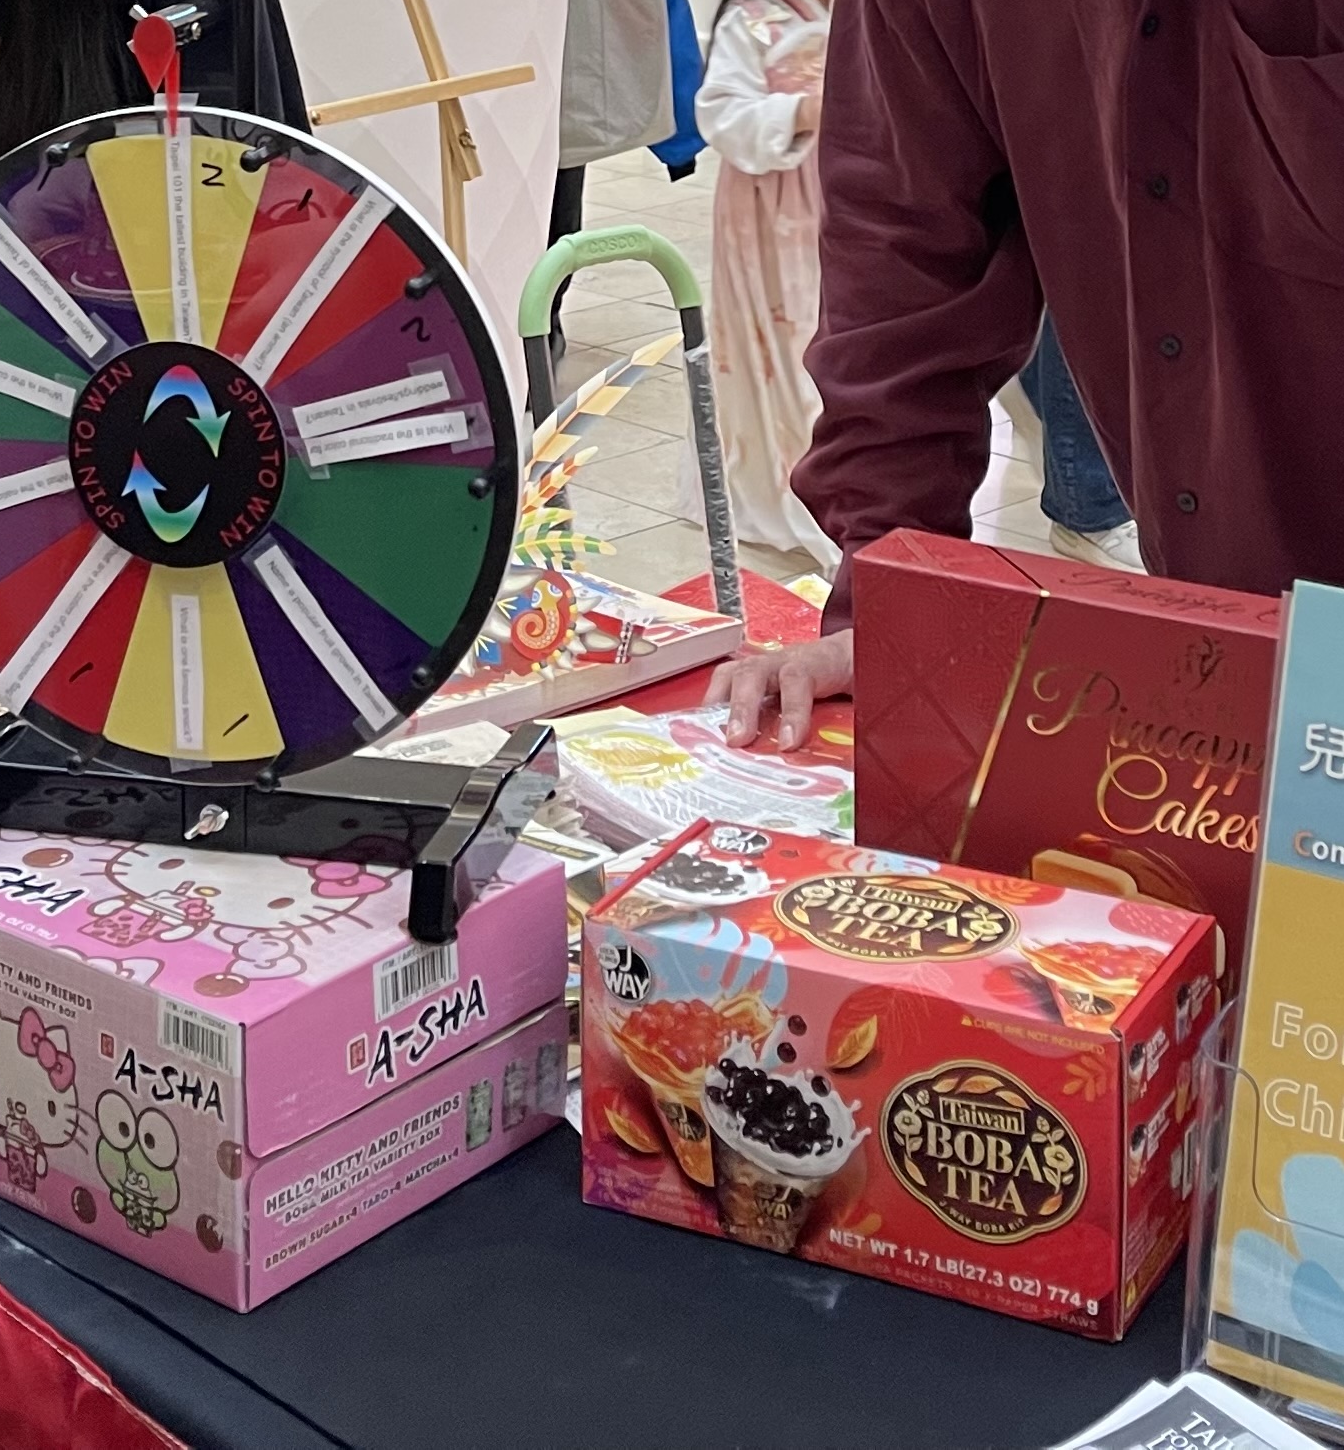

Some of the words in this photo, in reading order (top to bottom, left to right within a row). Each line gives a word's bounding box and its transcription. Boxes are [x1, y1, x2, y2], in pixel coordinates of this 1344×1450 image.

[173, 195, 183, 211] the
[174, 213, 186, 245] tallest
[588, 234, 638, 254] COSCO
[17, 257, 30, 271] of
[26, 265, 57, 298] capital
[174, 247, 188, 286] building
[50, 294, 68, 312] the
[71, 316, 96, 342] What
[8, 373, 27, 387] the
[36, 384, 64, 402] What
[82, 361, 133, 413] WIN
[226, 377, 276, 442] SPIN
[74, 420, 95, 458] TO
[395, 429, 413, 441] the
[258, 451, 280, 488] TO
[77, 465, 126, 529] SPIN
[219, 495, 271, 548] WIN
[1097, 745, 1259, 853] Cakes
[828, 892, 960, 938] BOBA
[869, 887, 956, 913] Taiwan
[831, 915, 923, 951] TEA
[4, 980, 20, 996] TEA
[21, 988, 58, 1011] VARIETY
[59, 1003, 78, 1020] BOX
[18, 970, 42, 990] AND
[45, 981, 93, 1010] FRIENDS
[605, 970, 651, 1000] WAY
[367, 979, 487, 1085] A-SHA
[114, 1048, 226, 1123] A-SHA
[944, 1101, 1021, 1132] Taiwan
[265, 1175, 315, 1215] HELLO
[319, 1148, 364, 1183] KITTY
[367, 1127, 400, 1159] AND
[403, 1094, 461, 1142] FRIENDS
[320, 1180, 349, 1205] MILK
[350, 1168, 372, 1188] TEA
[373, 1144, 418, 1174] VARIETY
[419, 1125, 442, 1148] BOX
[926, 1121, 1045, 1184] BOBA
[937, 1162, 1028, 1217] TEA
[948, 1207, 973, 1227] WAY
[975, 1221, 1007, 1235] BOBA
[1008, 1217, 1026, 1232] KIT
[264, 1238, 308, 1270] BROWN
[829, 1228, 866, 1250] NET
[869, 1239, 898, 1259] WT
[904, 1248, 930, 1266] 1.7
[1009, 1277, 1043, 1297] OZ)
[1047, 1285, 1083, 1307] 774
[1086, 1299, 1100, 1316] g
